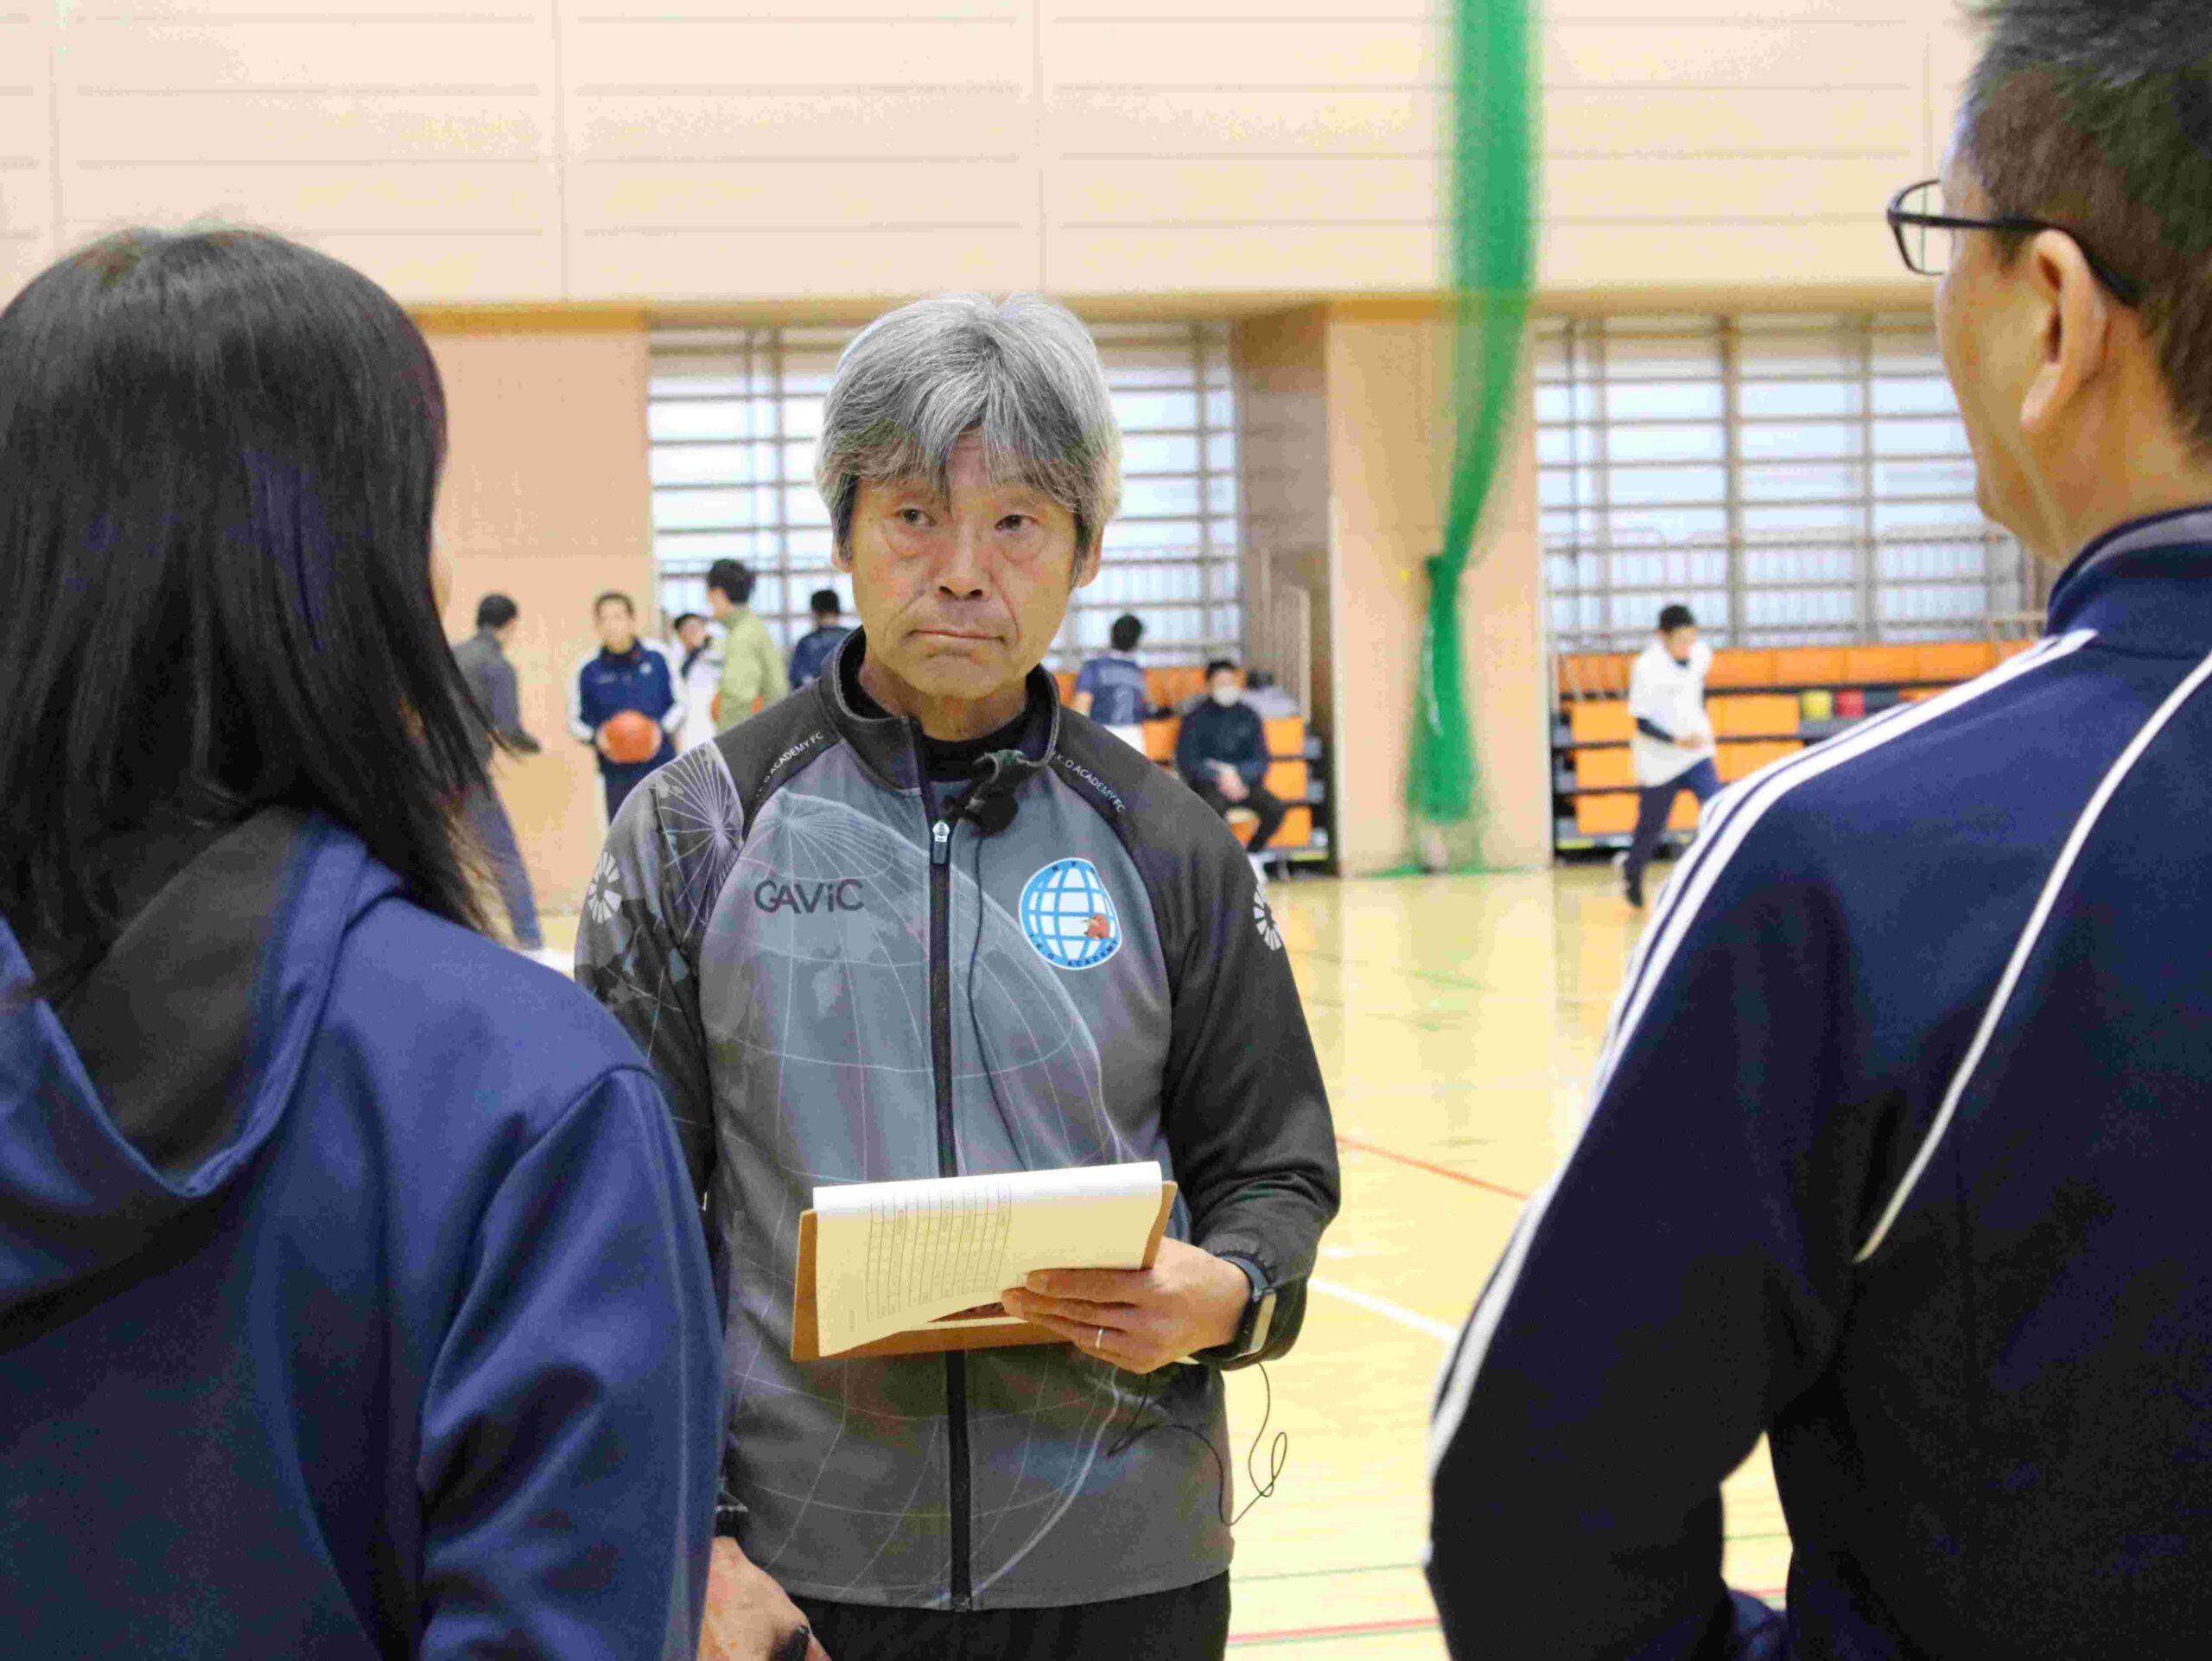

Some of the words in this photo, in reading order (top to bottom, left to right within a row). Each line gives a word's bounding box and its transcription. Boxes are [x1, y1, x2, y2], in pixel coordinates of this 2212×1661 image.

[770, 740, 810, 774] ACADEMY
[810, 731, 823, 744] FC
[1072, 765, 1116, 799] ACADEMY
[1113, 798, 1125, 812] FC
